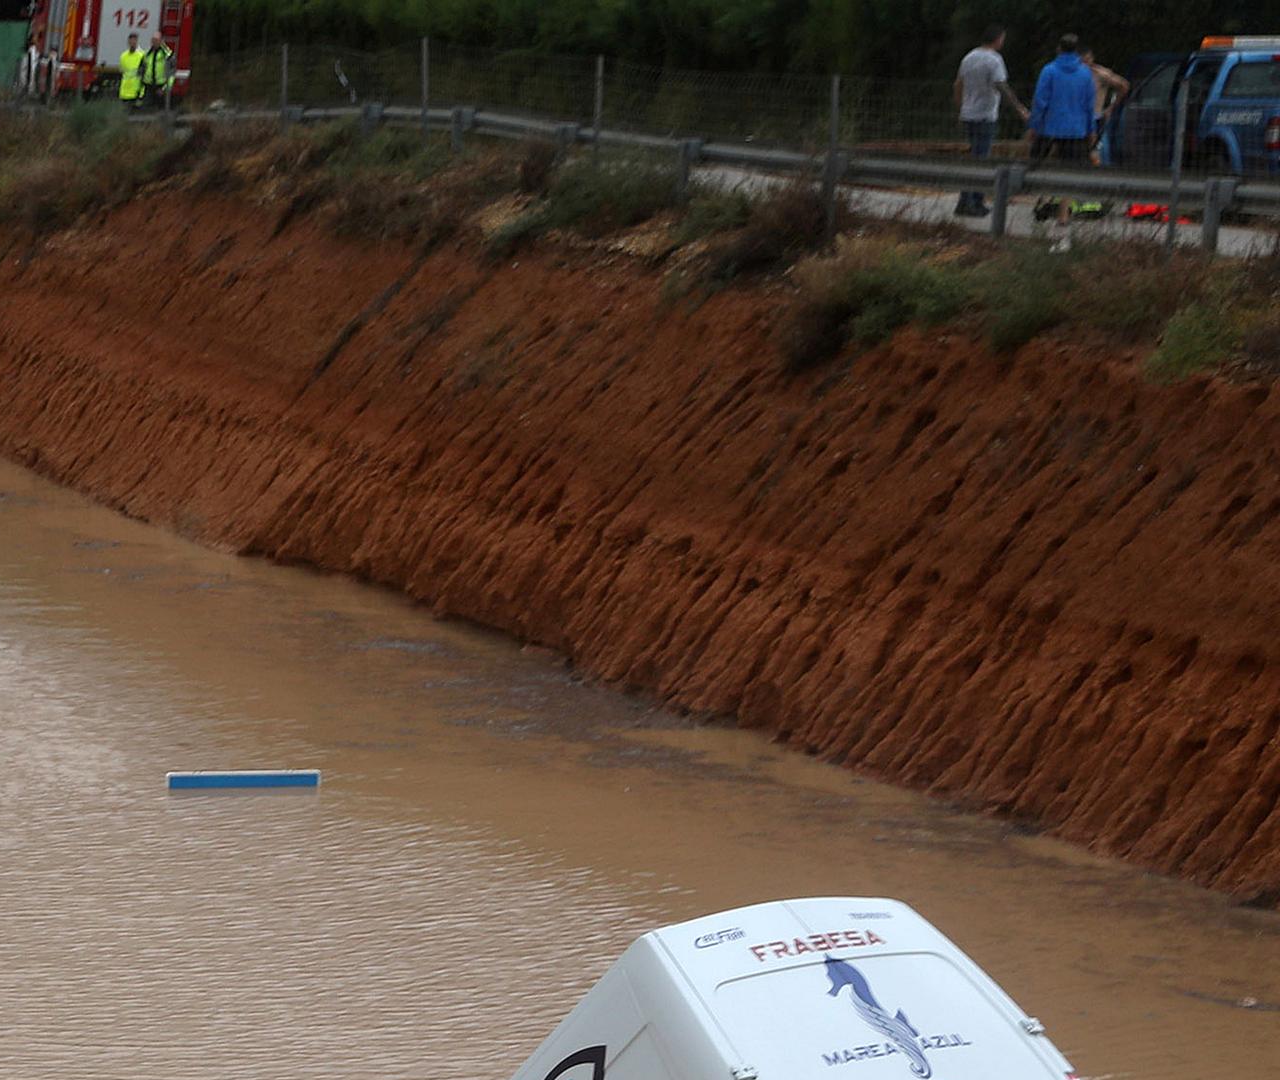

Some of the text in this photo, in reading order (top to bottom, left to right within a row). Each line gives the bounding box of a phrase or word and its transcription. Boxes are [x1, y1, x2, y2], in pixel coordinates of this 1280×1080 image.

[112, 8, 149, 28] 112
[748, 929, 887, 963] FRABESA
[821, 1033, 973, 1067] MAREA AZUL
